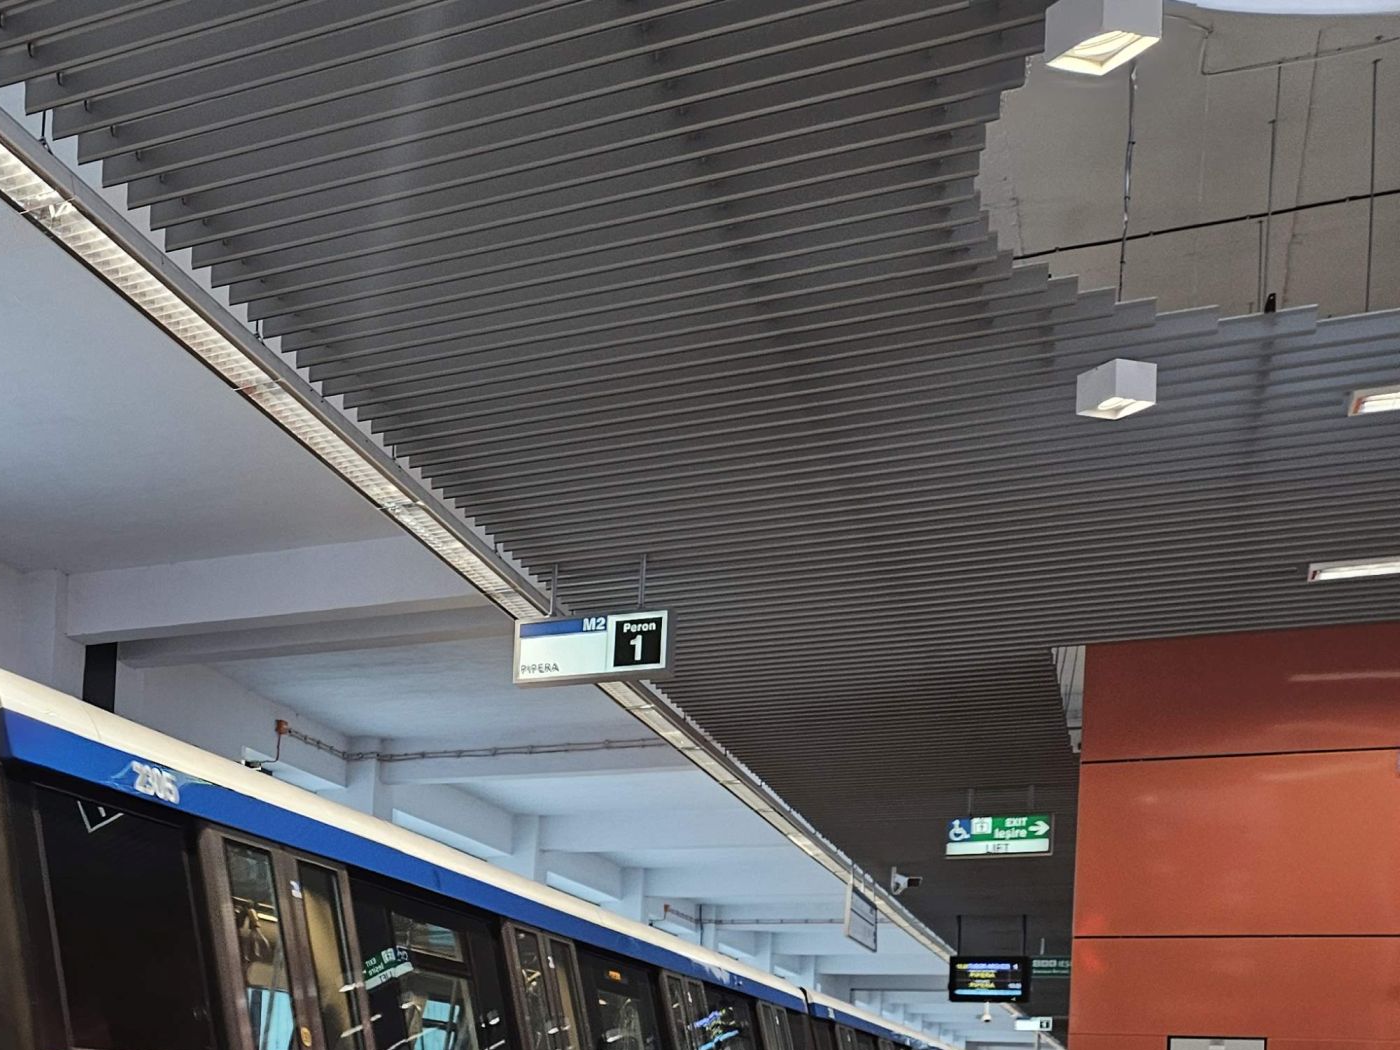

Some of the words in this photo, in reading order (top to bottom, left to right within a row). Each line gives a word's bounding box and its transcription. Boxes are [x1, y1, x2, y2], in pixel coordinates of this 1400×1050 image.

[583, 617, 605, 631] M2
[623, 622, 656, 632] Peron
[630, 635, 642, 660] 1
[521, 663, 559, 674] PIPERA
[1005, 817, 1028, 827] EXIT
[986, 843, 1009, 854] LIFT
